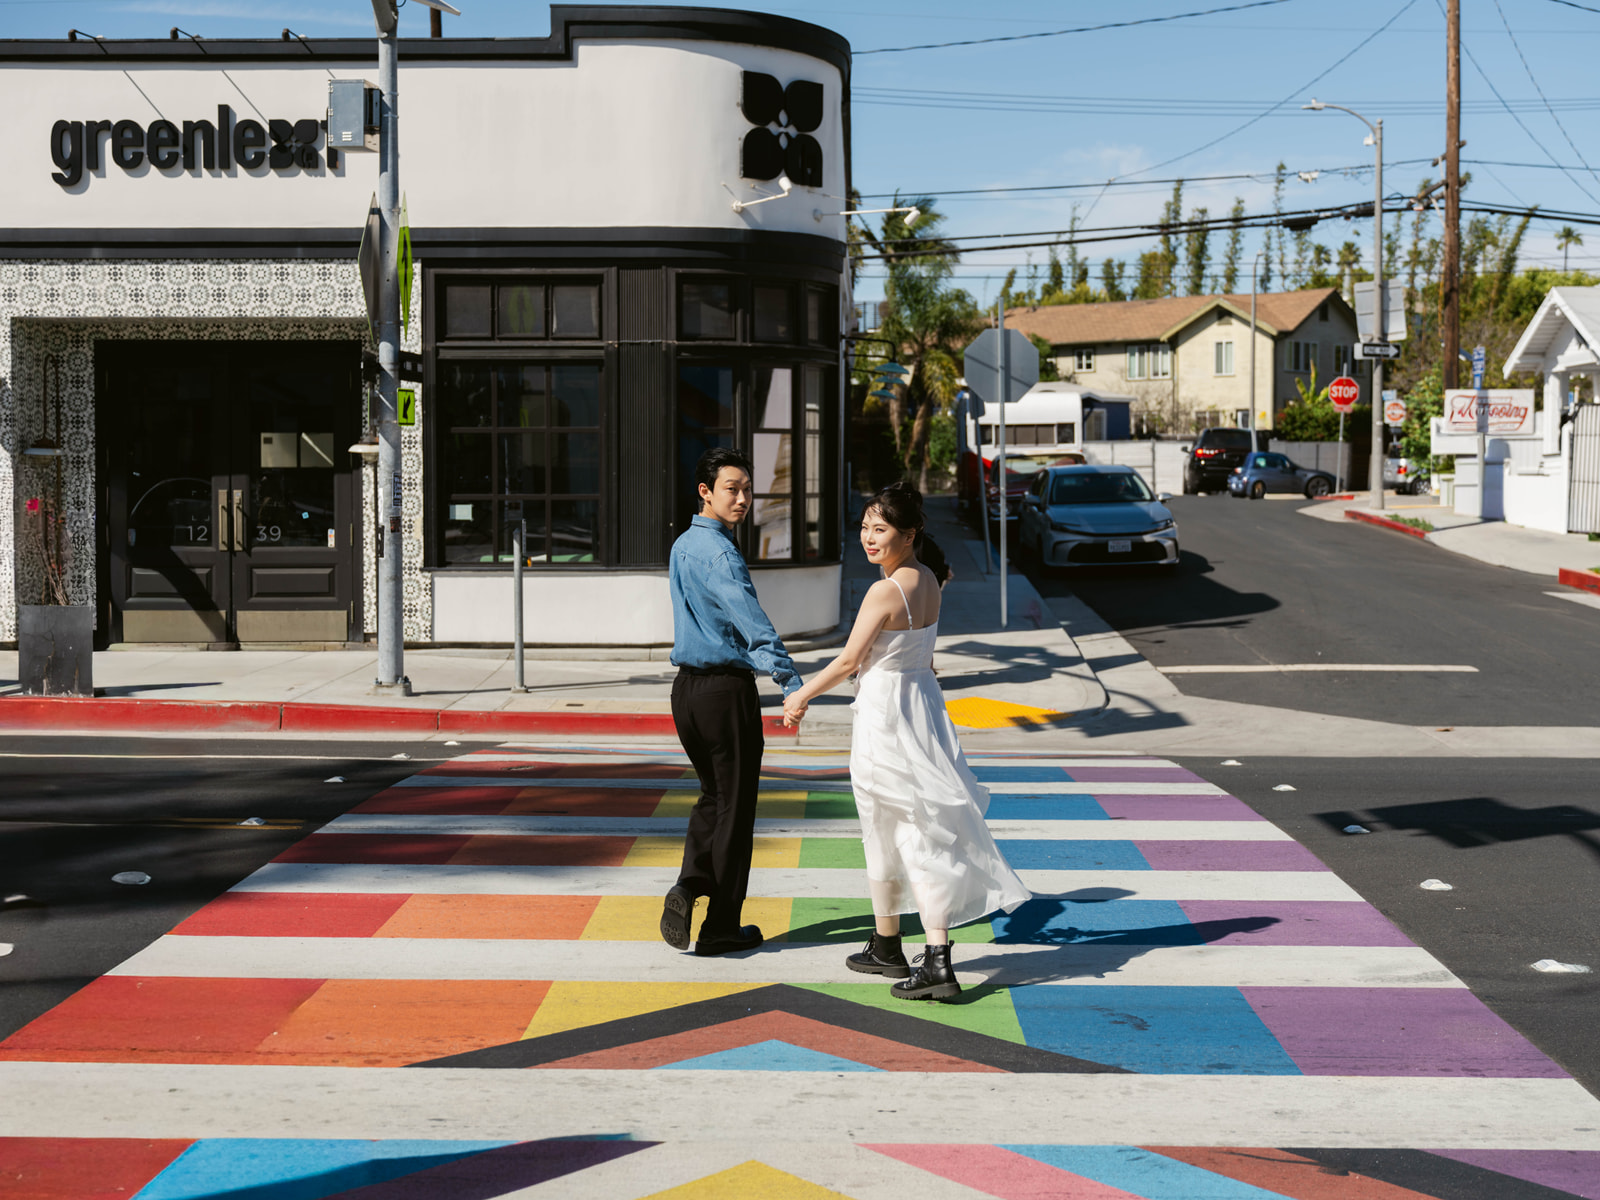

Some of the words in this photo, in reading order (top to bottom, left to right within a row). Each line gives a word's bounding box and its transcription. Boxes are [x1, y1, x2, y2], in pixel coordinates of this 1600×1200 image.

[1331, 386, 1357, 398] STOP
[187, 525, 208, 541] 12
[256, 525, 282, 542] 39
